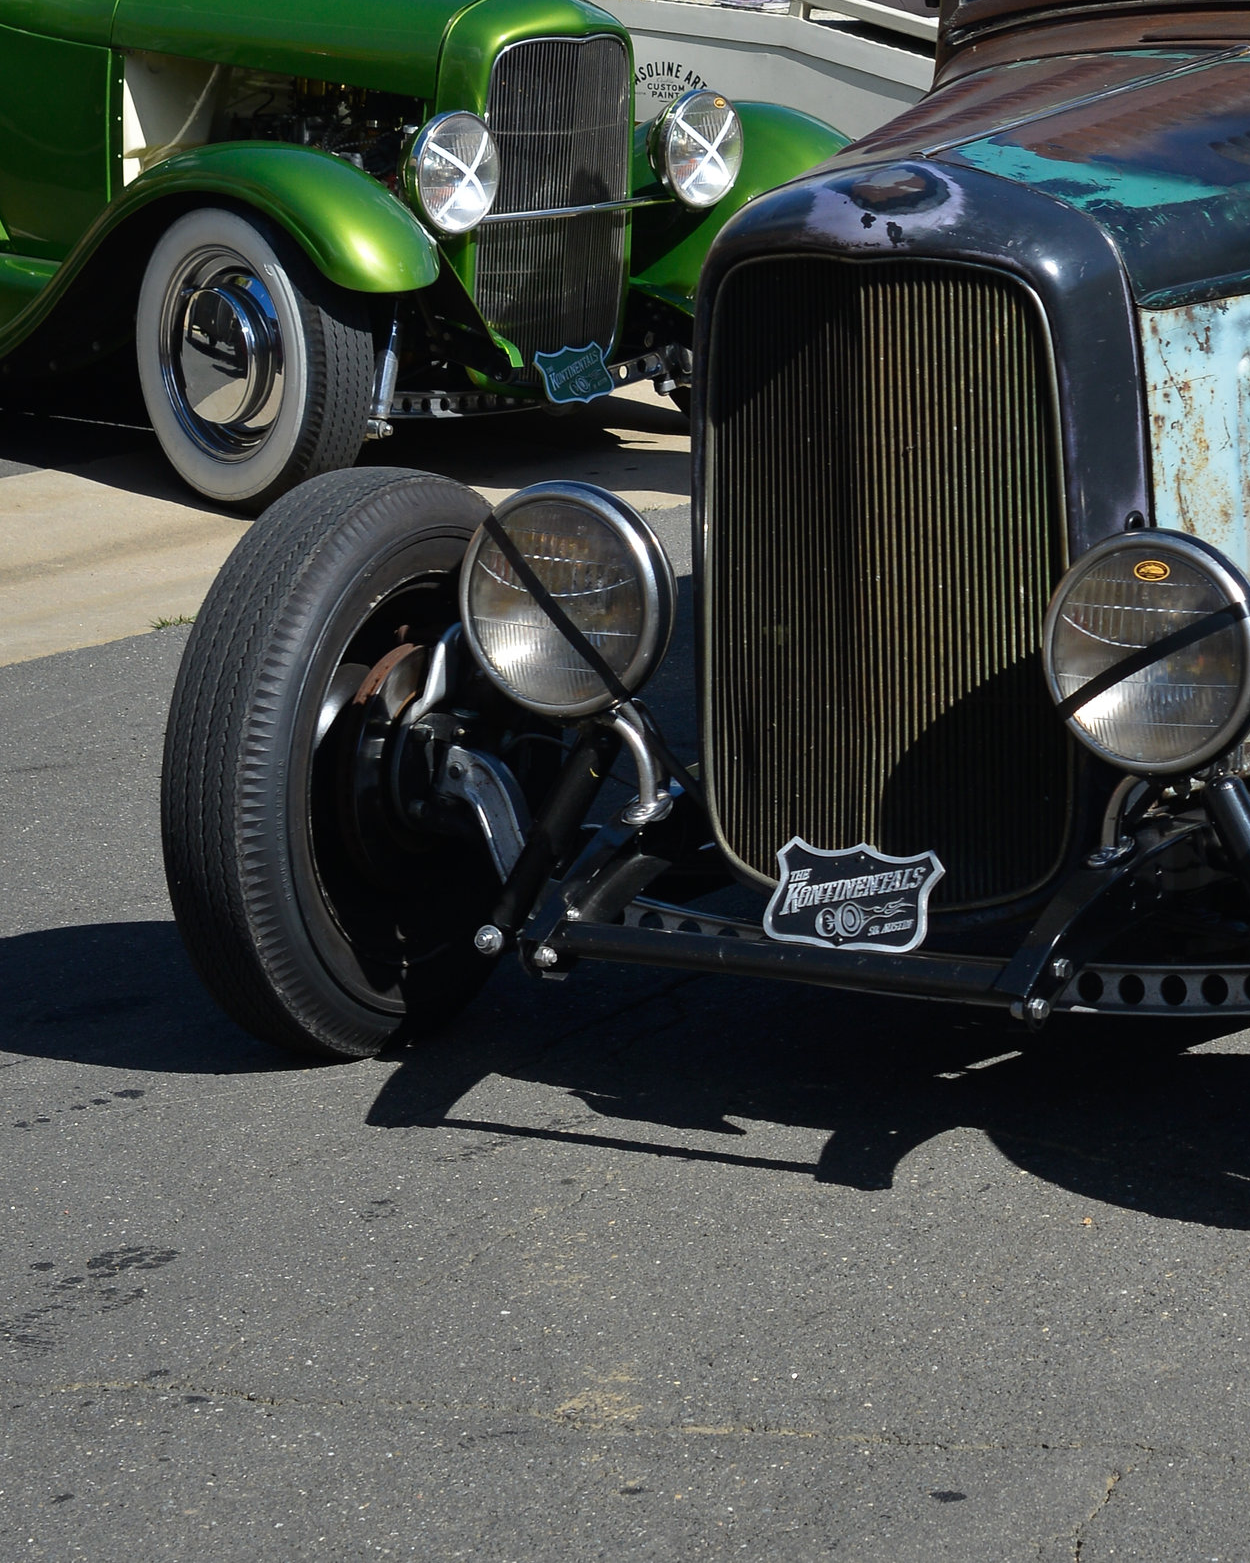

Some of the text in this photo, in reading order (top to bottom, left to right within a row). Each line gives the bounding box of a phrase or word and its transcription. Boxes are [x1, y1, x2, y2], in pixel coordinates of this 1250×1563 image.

[634, 61, 683, 86] ASOLINE
[647, 82, 685, 93] CUSTOM
[651, 90, 681, 99] PAINT
[789, 867, 813, 883] THE
[778, 866, 927, 916] KONTINENTALS
